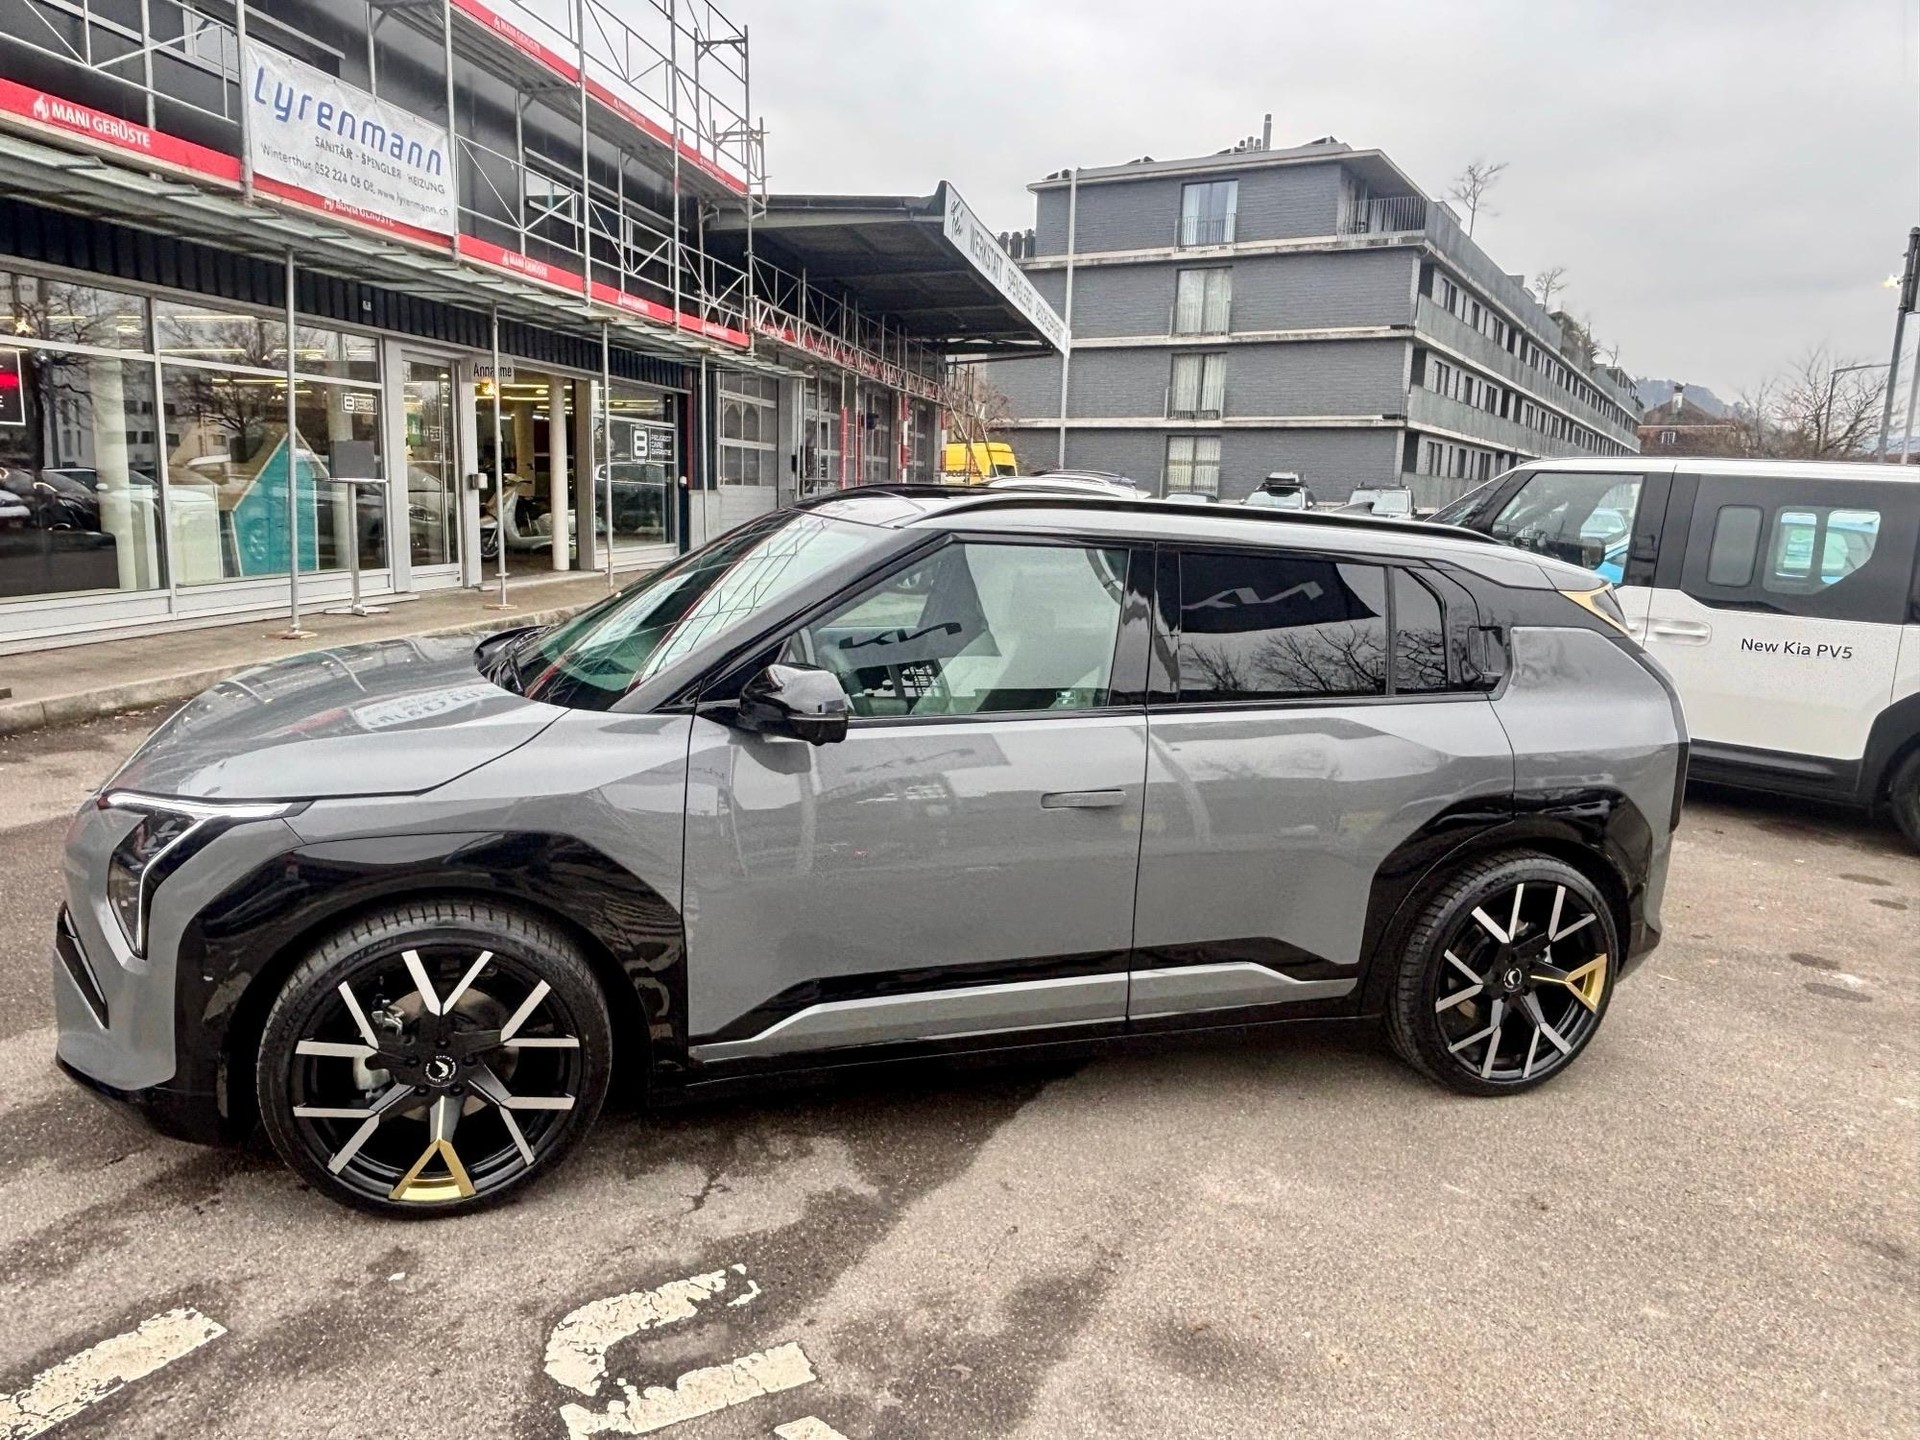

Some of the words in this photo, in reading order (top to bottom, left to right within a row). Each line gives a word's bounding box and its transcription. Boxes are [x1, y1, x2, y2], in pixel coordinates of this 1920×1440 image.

[51, 102, 90, 129] MANI
[92, 117, 151, 148] GERÜSTE
[314, 135, 353, 160] SANITÄR
[314, 161, 331, 179] 052
[331, 168, 348, 184] 224
[473, 361, 512, 377] Anname
[1741, 638, 1780, 653] New
[1783, 641, 1811, 656] Kia
[1816, 644, 1853, 660] PV5
